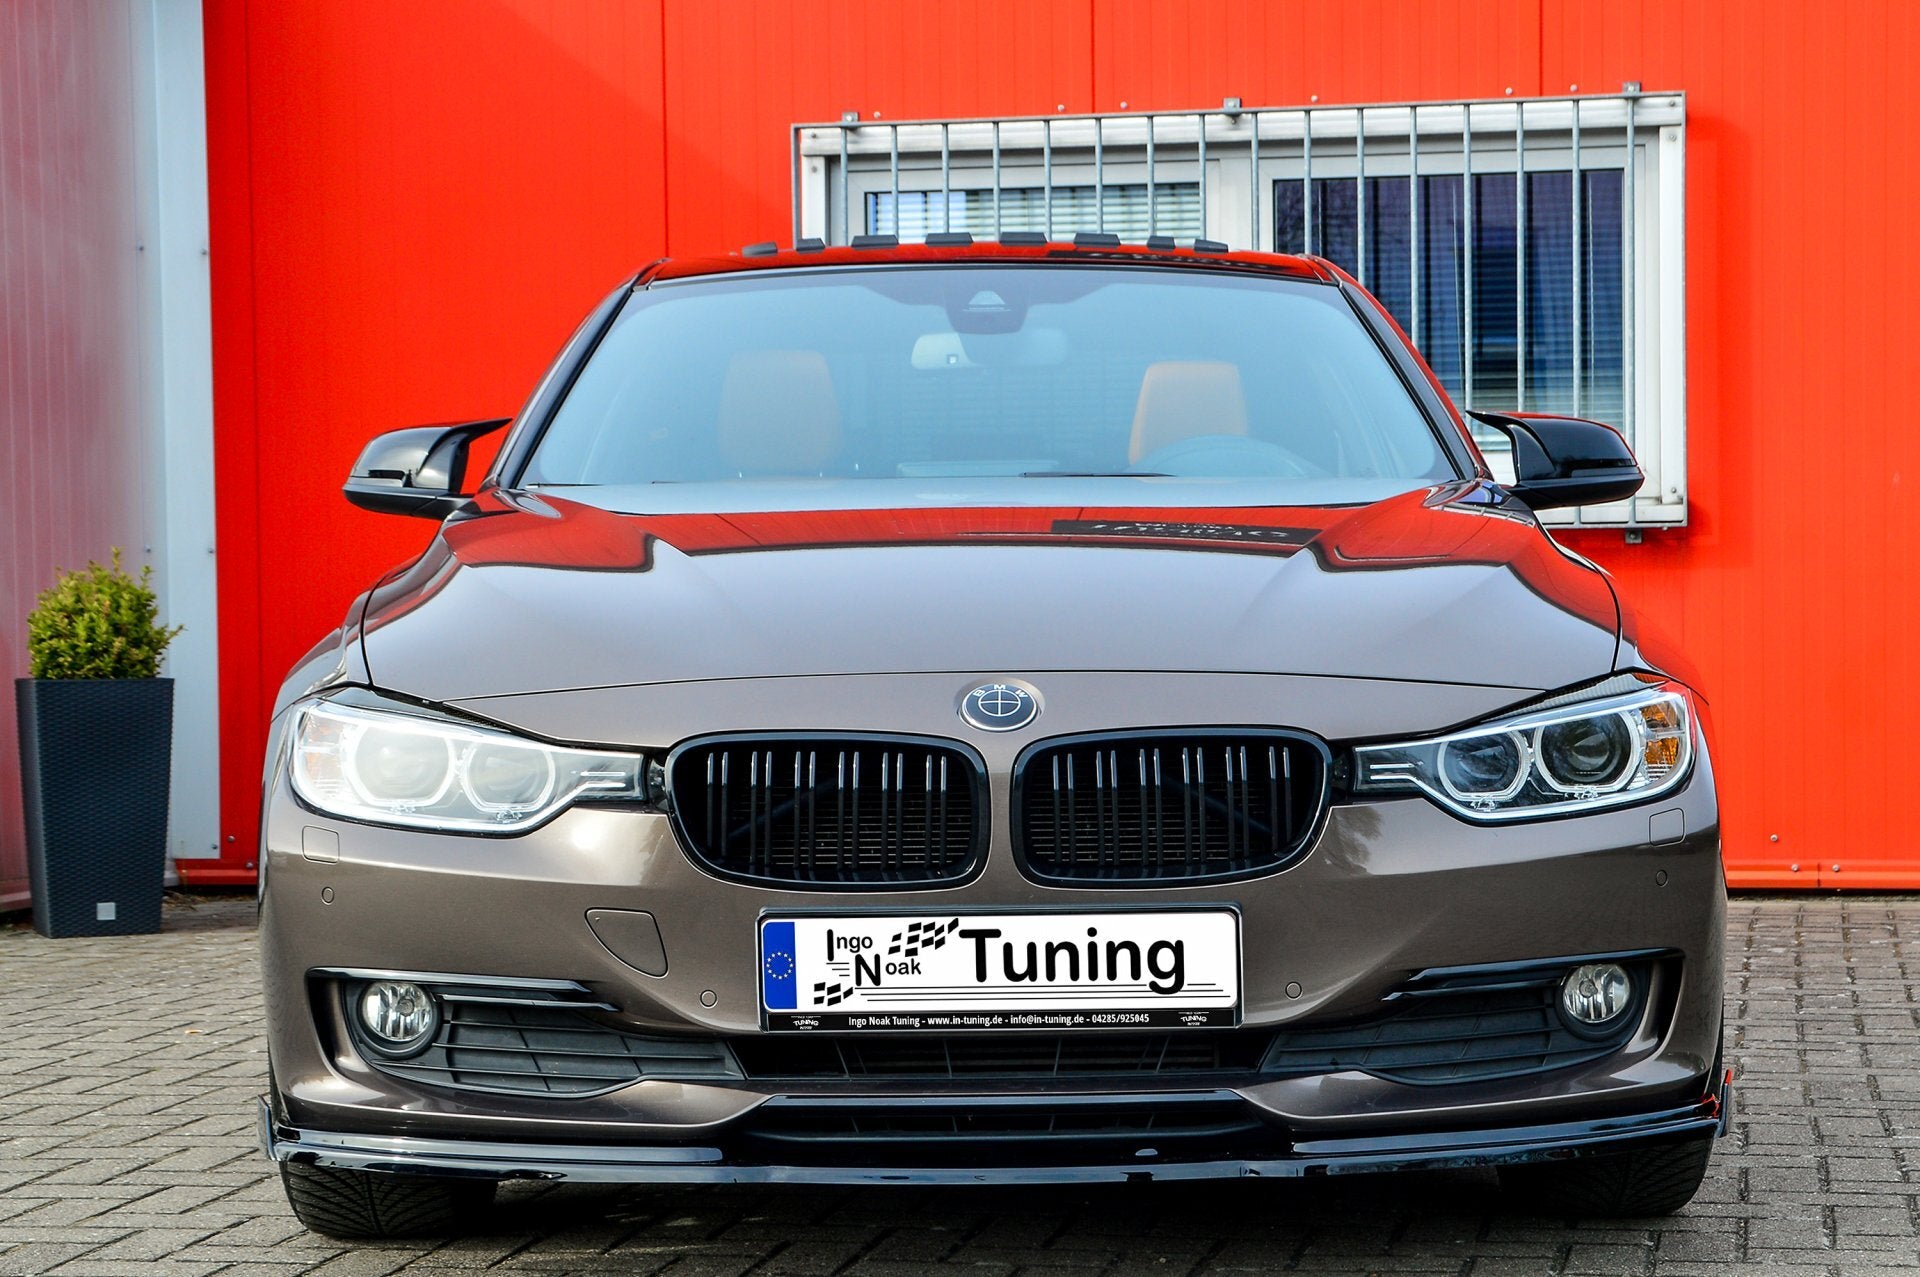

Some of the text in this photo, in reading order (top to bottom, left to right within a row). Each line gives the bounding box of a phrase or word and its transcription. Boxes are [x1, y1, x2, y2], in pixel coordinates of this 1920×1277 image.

[972, 683, 1029, 698] BMW
[827, 928, 873, 961] Ingo
[958, 926, 1186, 996] Tuning
[855, 953, 922, 987] Noak
[848, 1016, 867, 1028] Ingo
[868, 1016, 891, 1026] Noak
[891, 1016, 921, 1028] Tuning
[927, 1015, 1003, 1027] www.in-tuning.de
[1010, 1014, 1084, 1026] info@in-tuning.de
[1092, 1013, 1150, 1025] 04285/925045
